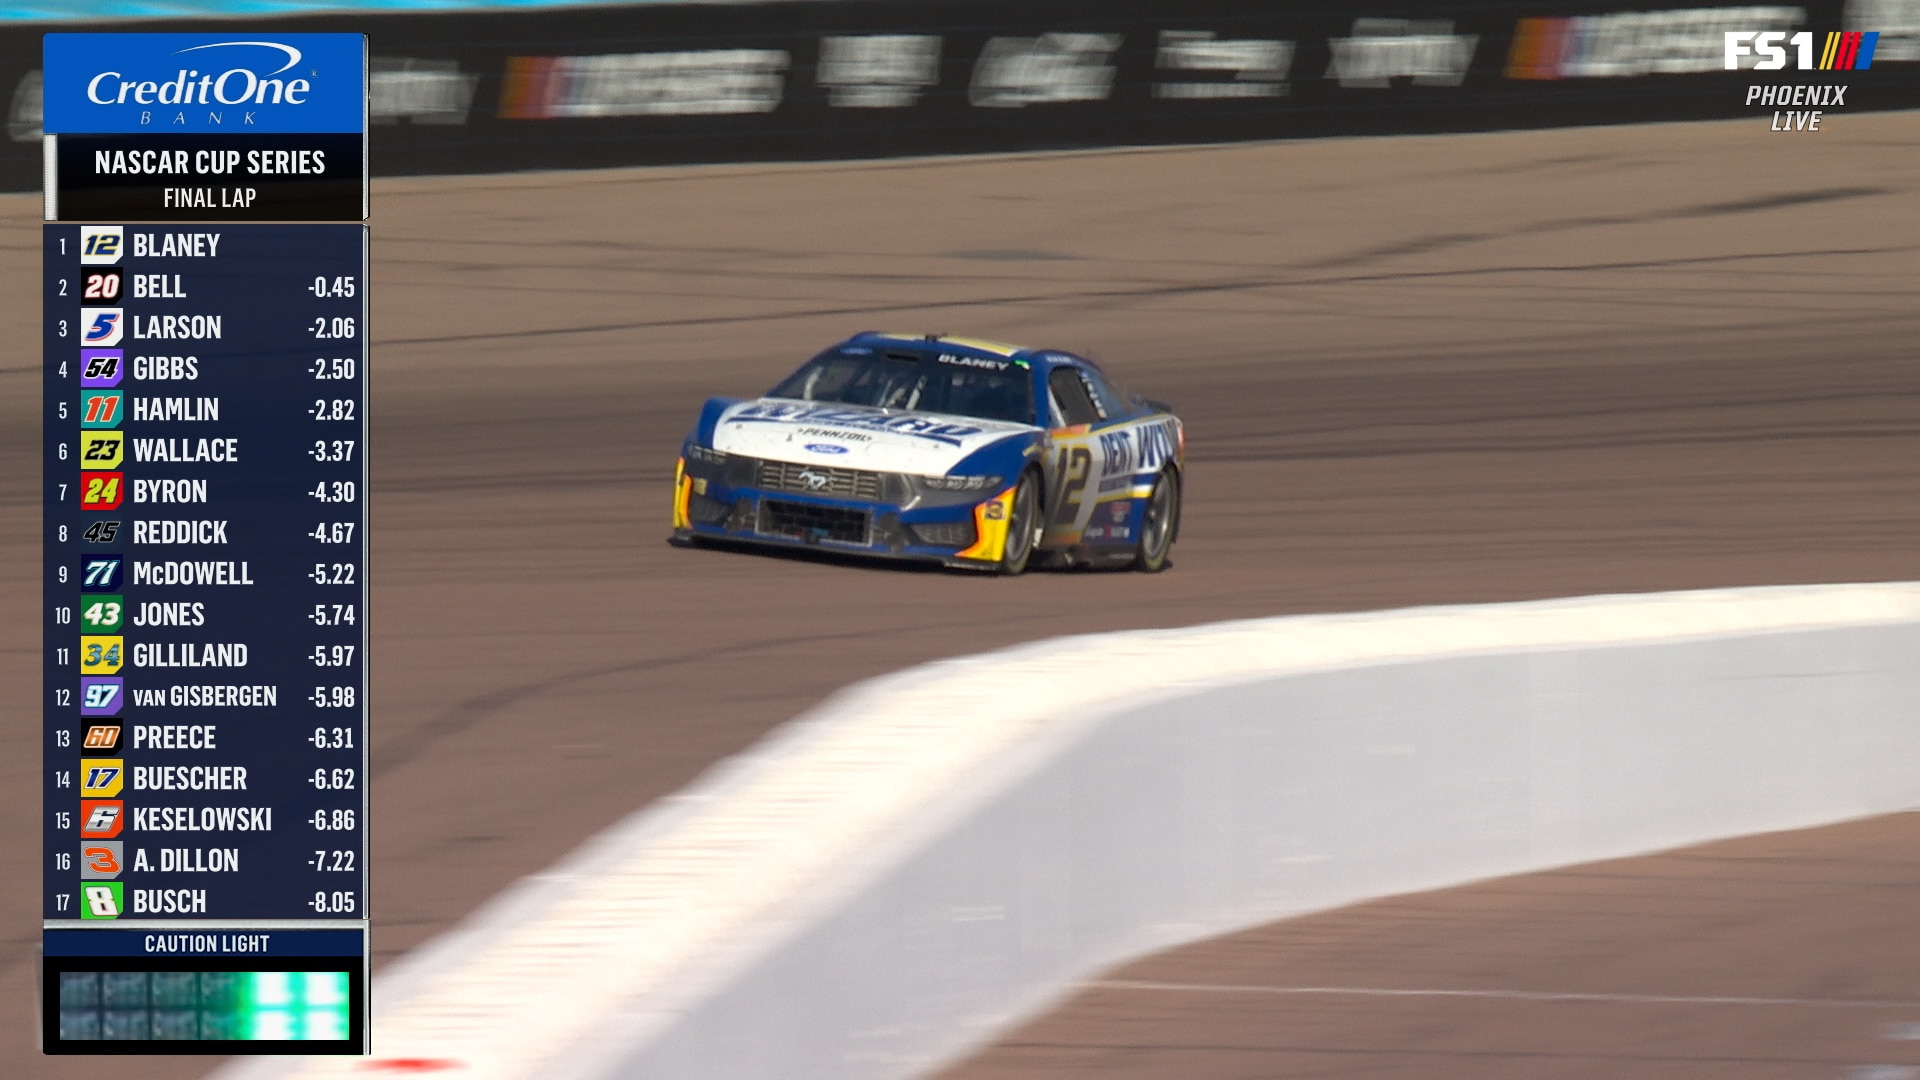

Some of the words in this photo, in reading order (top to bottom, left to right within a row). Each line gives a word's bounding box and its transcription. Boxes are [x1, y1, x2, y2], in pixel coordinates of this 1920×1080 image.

[938, 354, 1009, 372] BLANEY
[801, 428, 867, 443] PENNZOIL
[1050, 442, 1093, 525] 12
